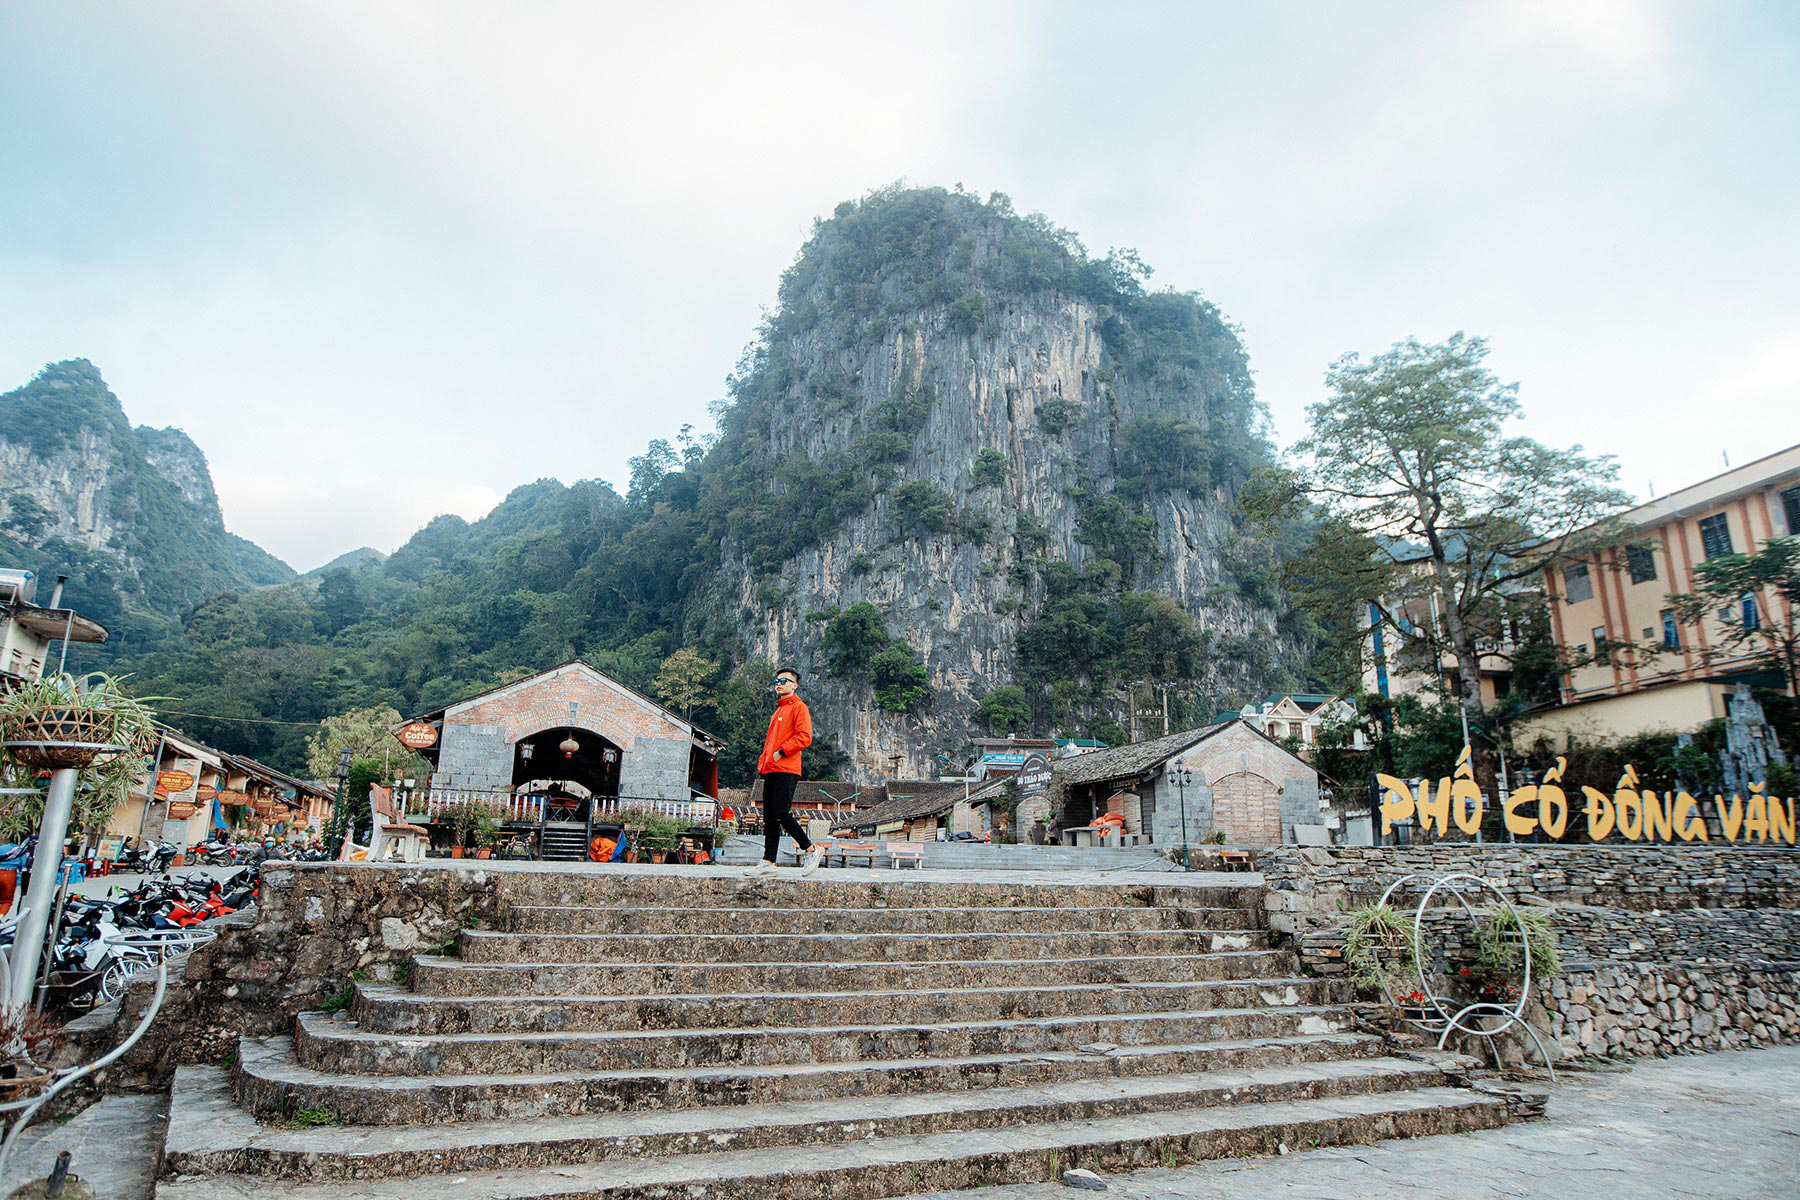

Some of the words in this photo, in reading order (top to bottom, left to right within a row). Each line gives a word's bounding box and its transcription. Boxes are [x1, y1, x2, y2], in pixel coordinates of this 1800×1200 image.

[405, 731, 435, 740] Coffee
[1376, 744, 1484, 837] PHỐ
[1504, 756, 1568, 839] CỔ
[1581, 763, 1709, 842] ĐỒNG
[1715, 781, 1796, 845] VĂN
